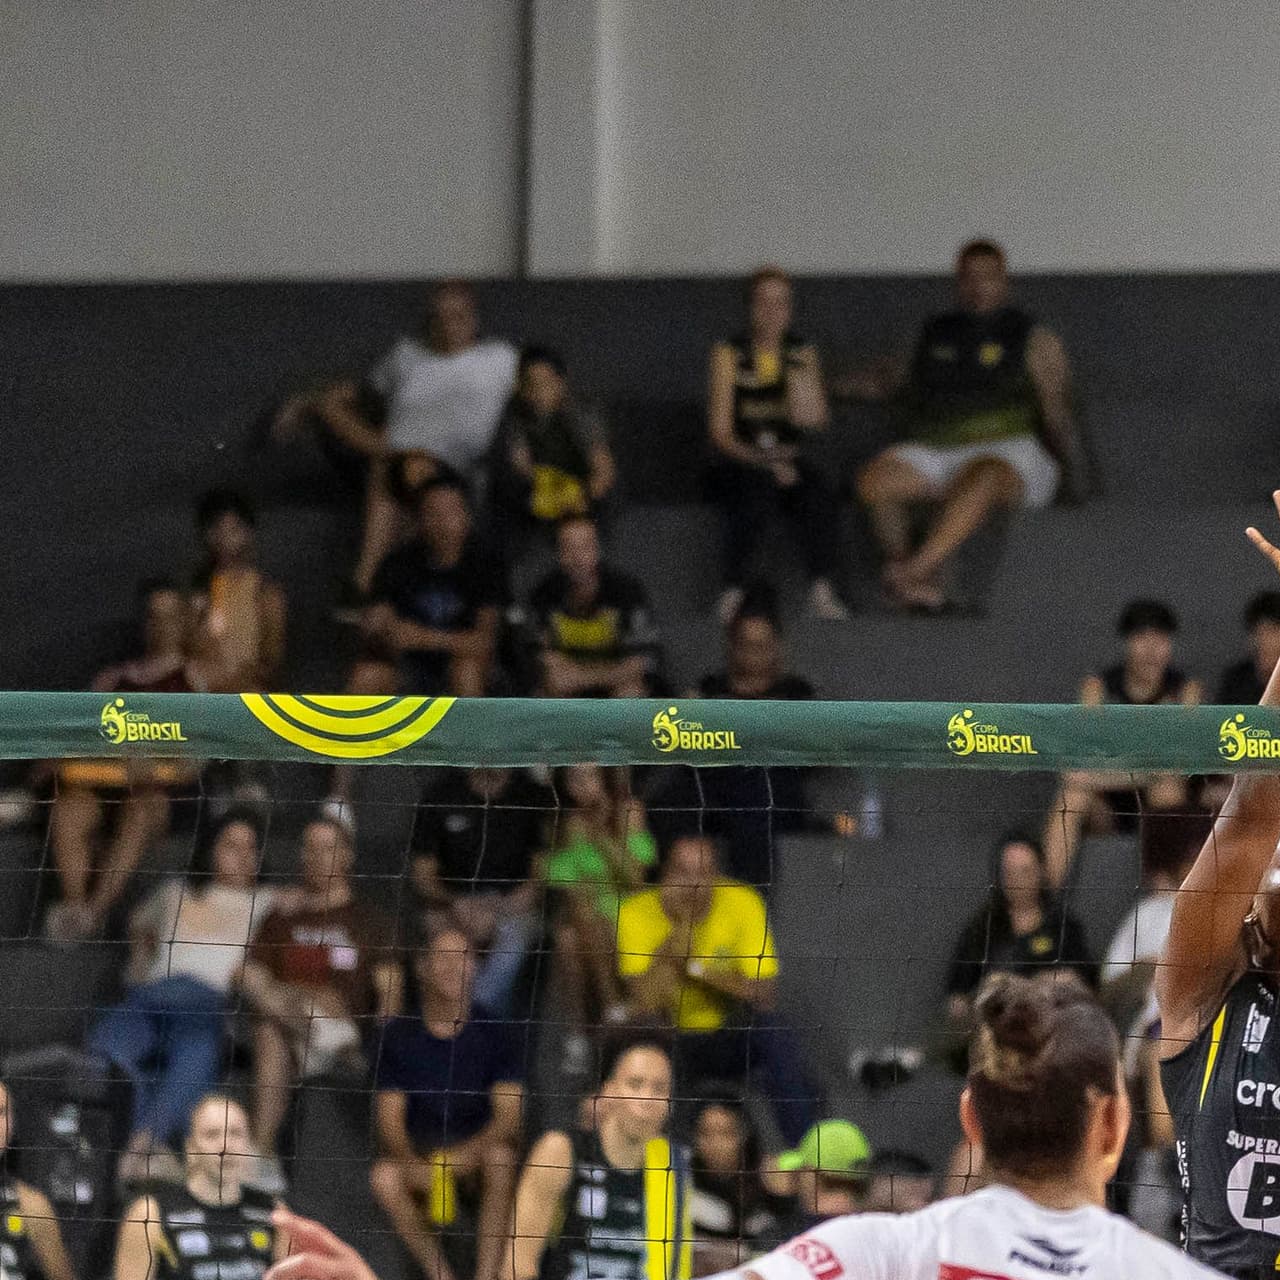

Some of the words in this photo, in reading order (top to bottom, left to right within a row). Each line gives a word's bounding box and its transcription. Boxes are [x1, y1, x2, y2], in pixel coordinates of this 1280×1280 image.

[127, 713, 149, 722] COPA
[680, 719, 703, 730] COPA
[975, 724, 998, 734] COPA
[127, 722, 188, 742] BRASIL
[1246, 728, 1271, 738] COPA
[680, 731, 741, 750] BRASIL
[975, 735, 1038, 754] BRASIL
